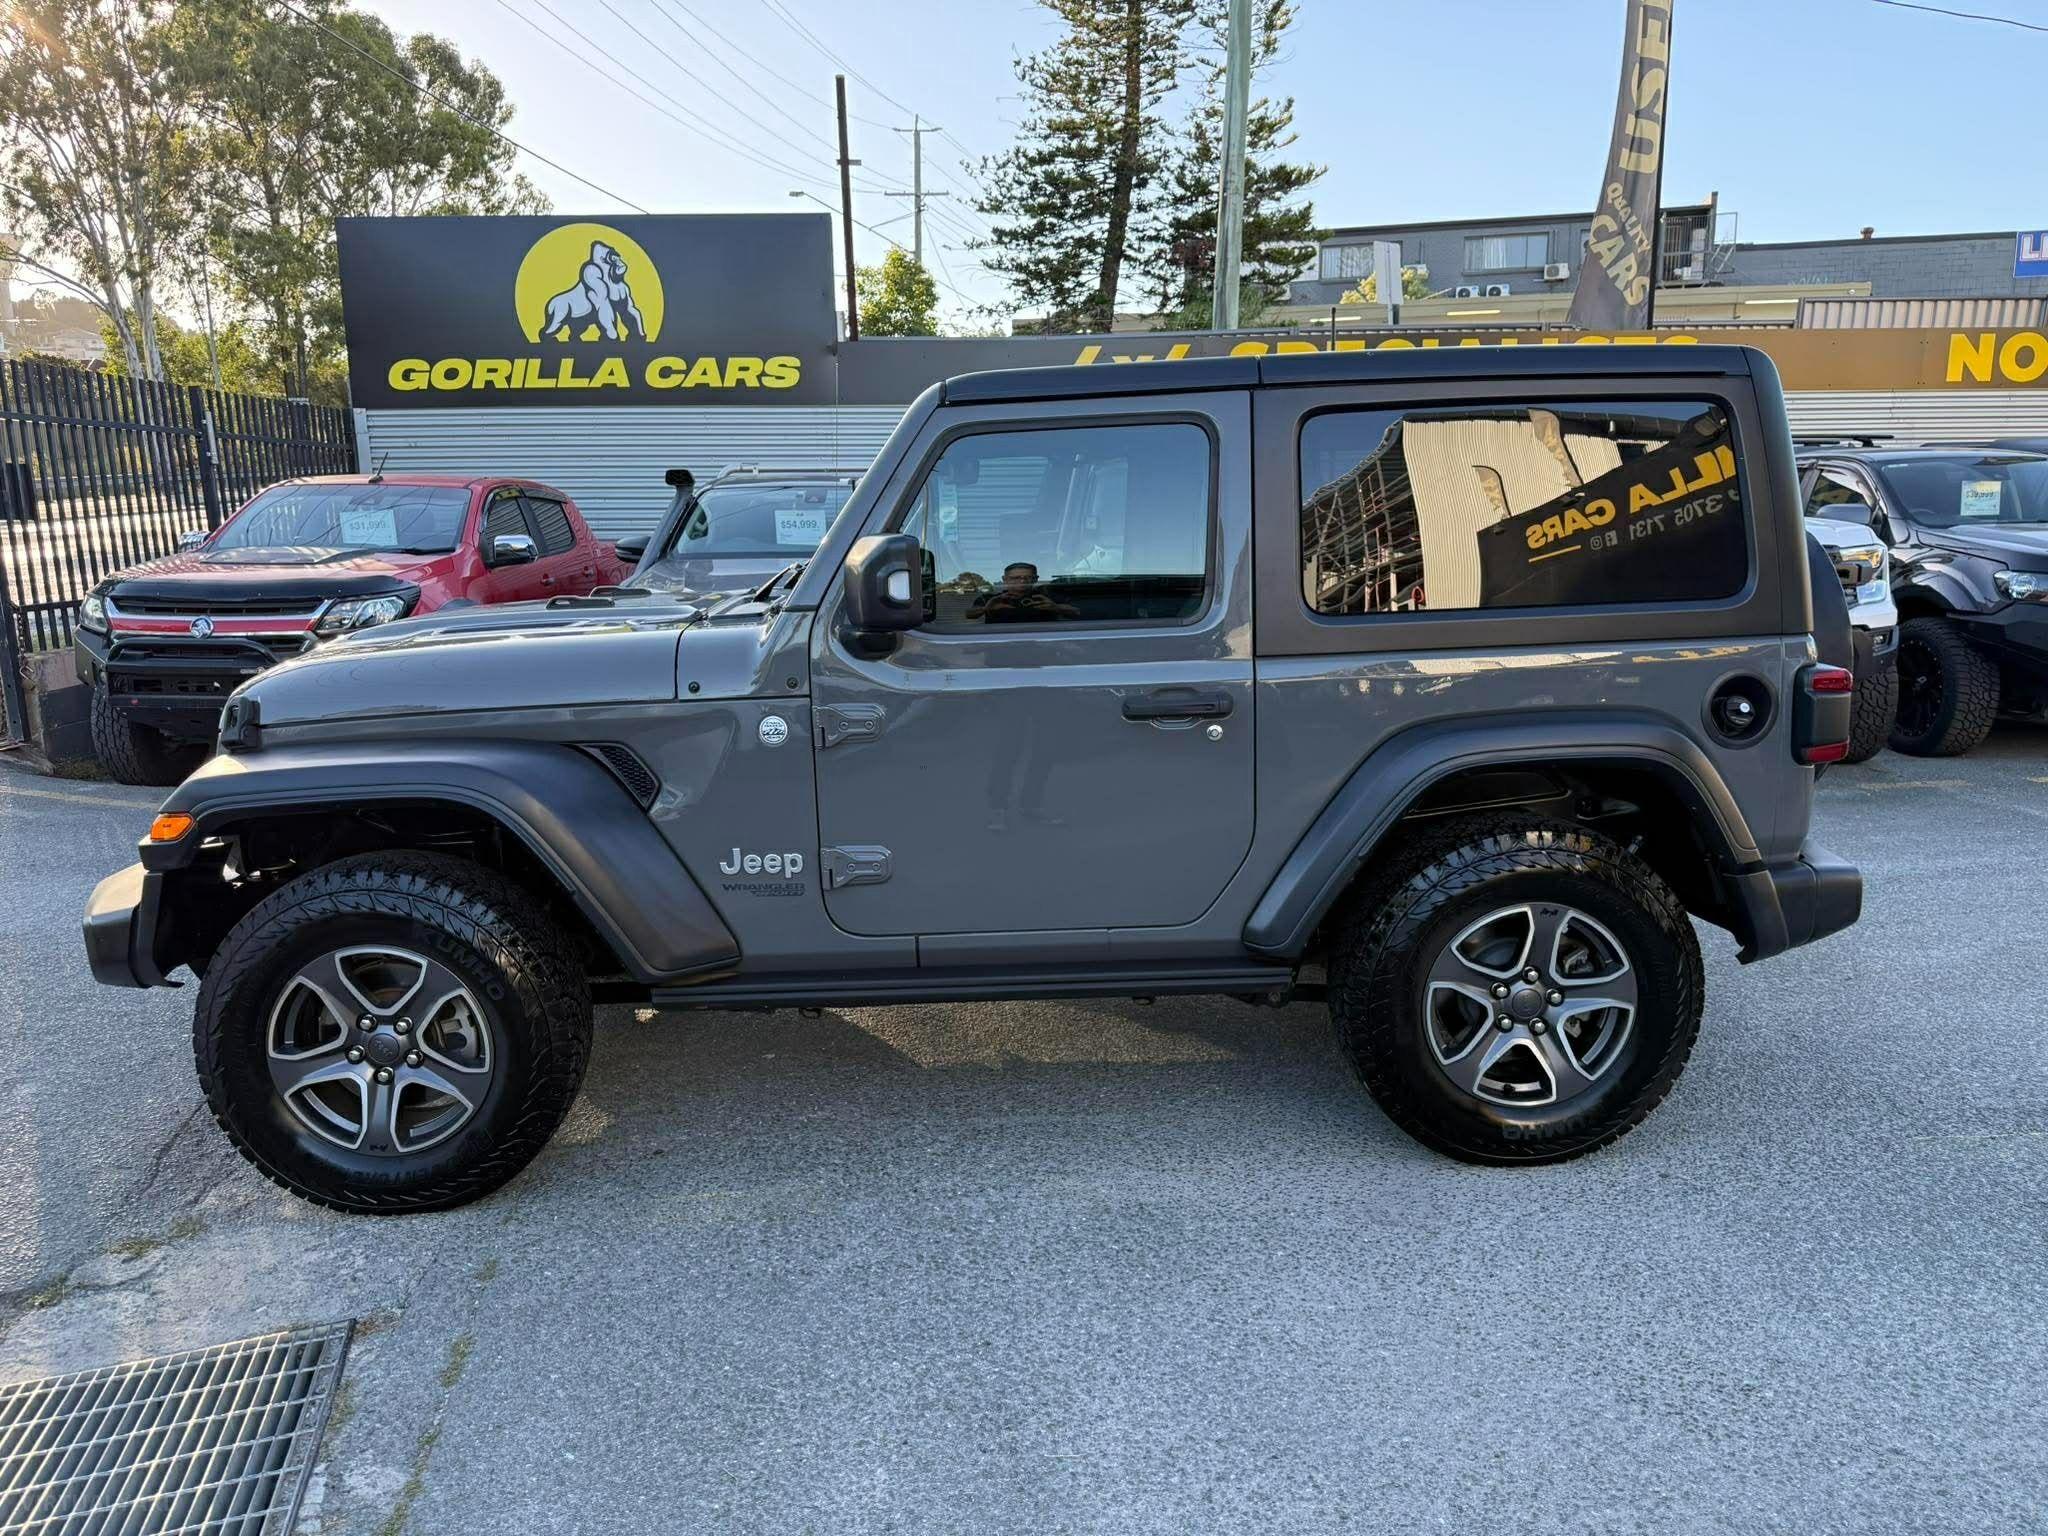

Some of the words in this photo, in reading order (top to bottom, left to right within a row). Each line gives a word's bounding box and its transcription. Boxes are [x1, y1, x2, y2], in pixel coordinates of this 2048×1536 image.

[1618, 0, 1670, 174] USE
[1606, 182, 1652, 253] QUALITY
[1588, 213, 1650, 306] CARS
[388, 357, 631, 390] GORILLA
[645, 356, 801, 389] CARS
[1946, 332, 2048, 383] NO
[719, 847, 804, 878] Jeep
